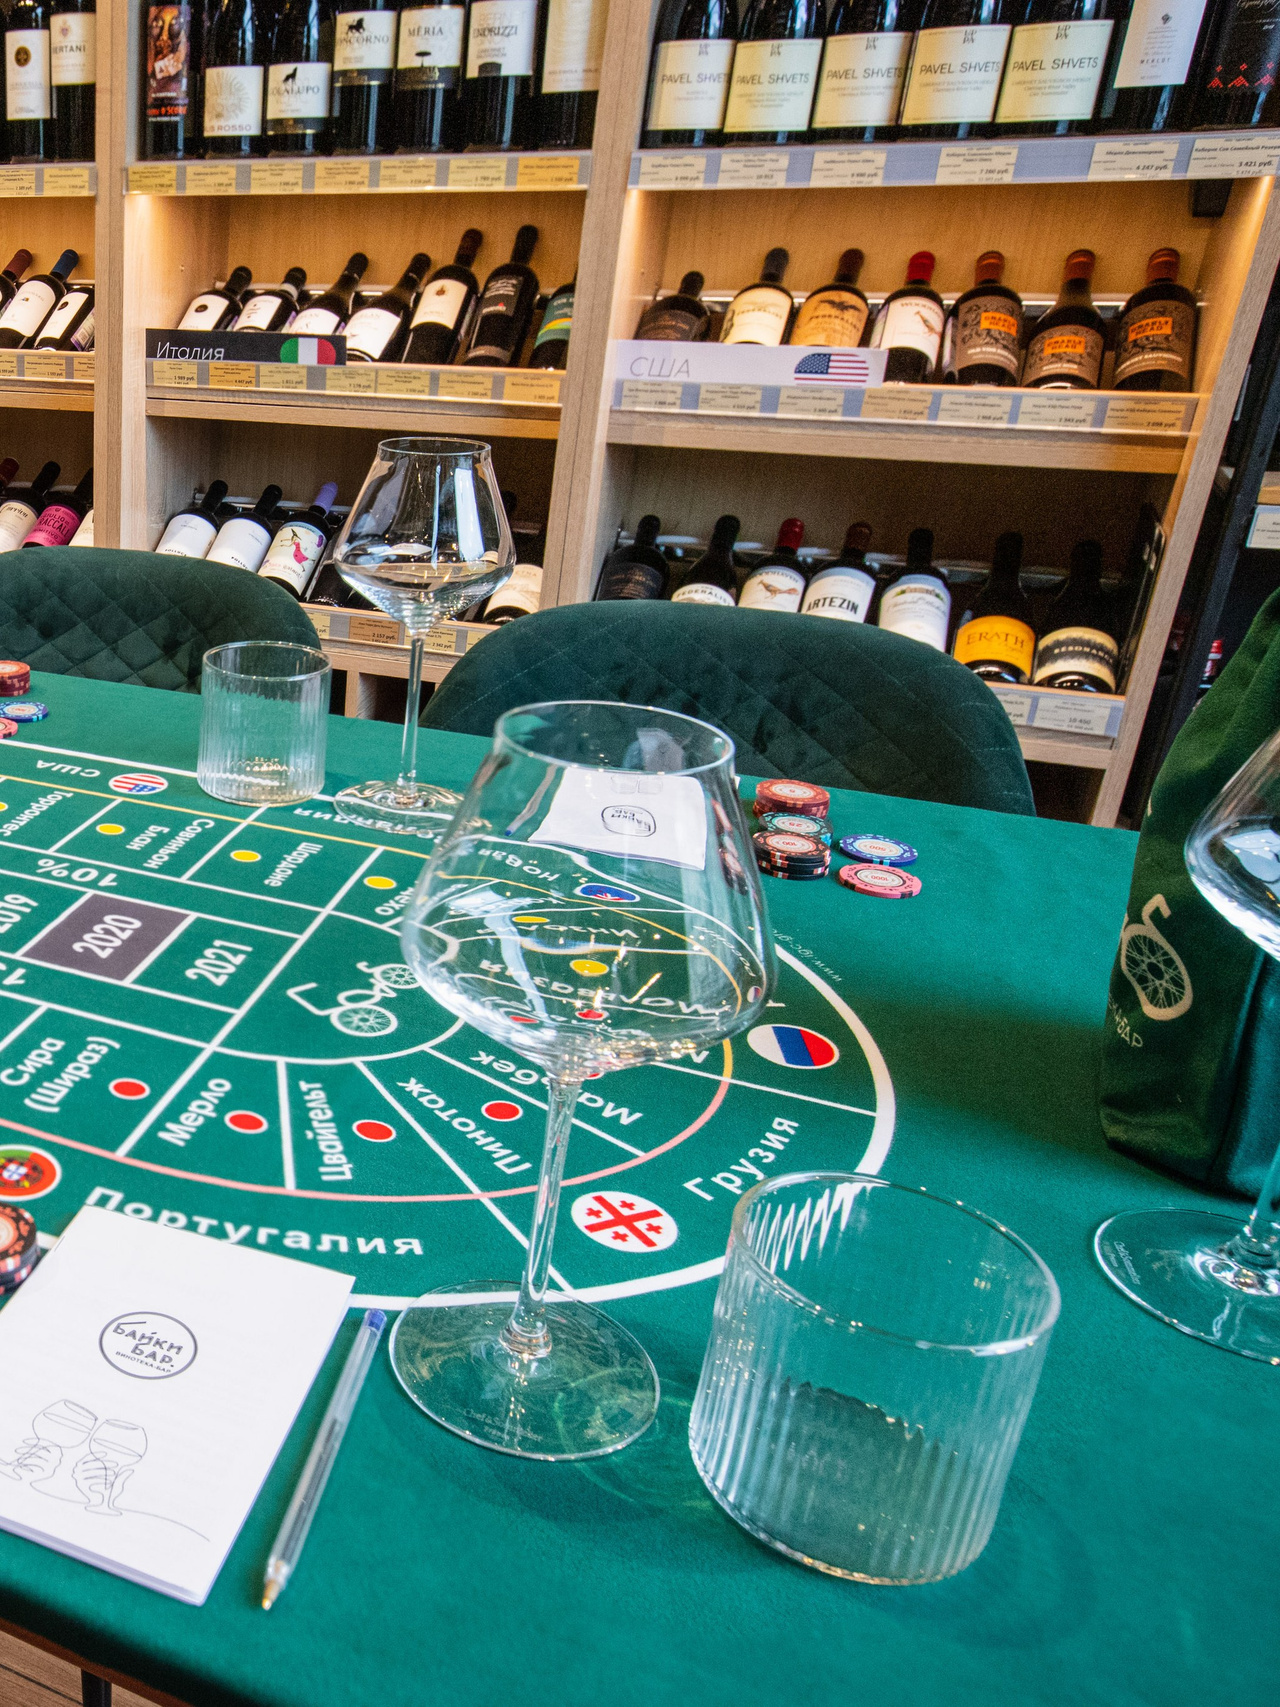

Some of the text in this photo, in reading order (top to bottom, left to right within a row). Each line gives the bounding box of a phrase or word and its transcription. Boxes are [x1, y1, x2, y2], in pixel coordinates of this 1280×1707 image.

[662, 73, 691, 84] PAVEL
[736, 72, 810, 85] PAVEL SHVETS
[826, 68, 858, 81] PAVEL
[920, 60, 1001, 75] PAVEL SHVETS
[1012, 57, 1099, 72] PAVEL SHVETS
[157, 341, 225, 360] Италия
[630, 356, 690, 378] США
[806, 596, 859, 615] ARTEZIN
[387, 633, 396, 641] руб.
[966, 631, 1025, 649] ERATH
[36, 760, 101, 778] США
[126, 824, 169, 852] Блан
[143, 817, 214, 869] Совиньон
[36, 858, 119, 888] 10%
[264, 841, 323, 887] Шардоне
[71, 914, 142, 959] 2020
[184, 938, 254, 987] 2021
[0, 1036, 65, 1087] Сира
[24, 1036, 121, 1113] (Шираз)
[469, 1049, 643, 1126] Мабек
[157, 1078, 231, 1148] Мерло
[398, 1077, 533, 1175] Пинотаж
[299, 1080, 354, 1182] Цвайгельт
[683, 1116, 801, 1202] Грузия
[85, 1185, 425, 1256] Португалия
[112, 1321, 184, 1355] БАЙКИ
[115, 1350, 172, 1373] ВИНОТЕКА-БАР
